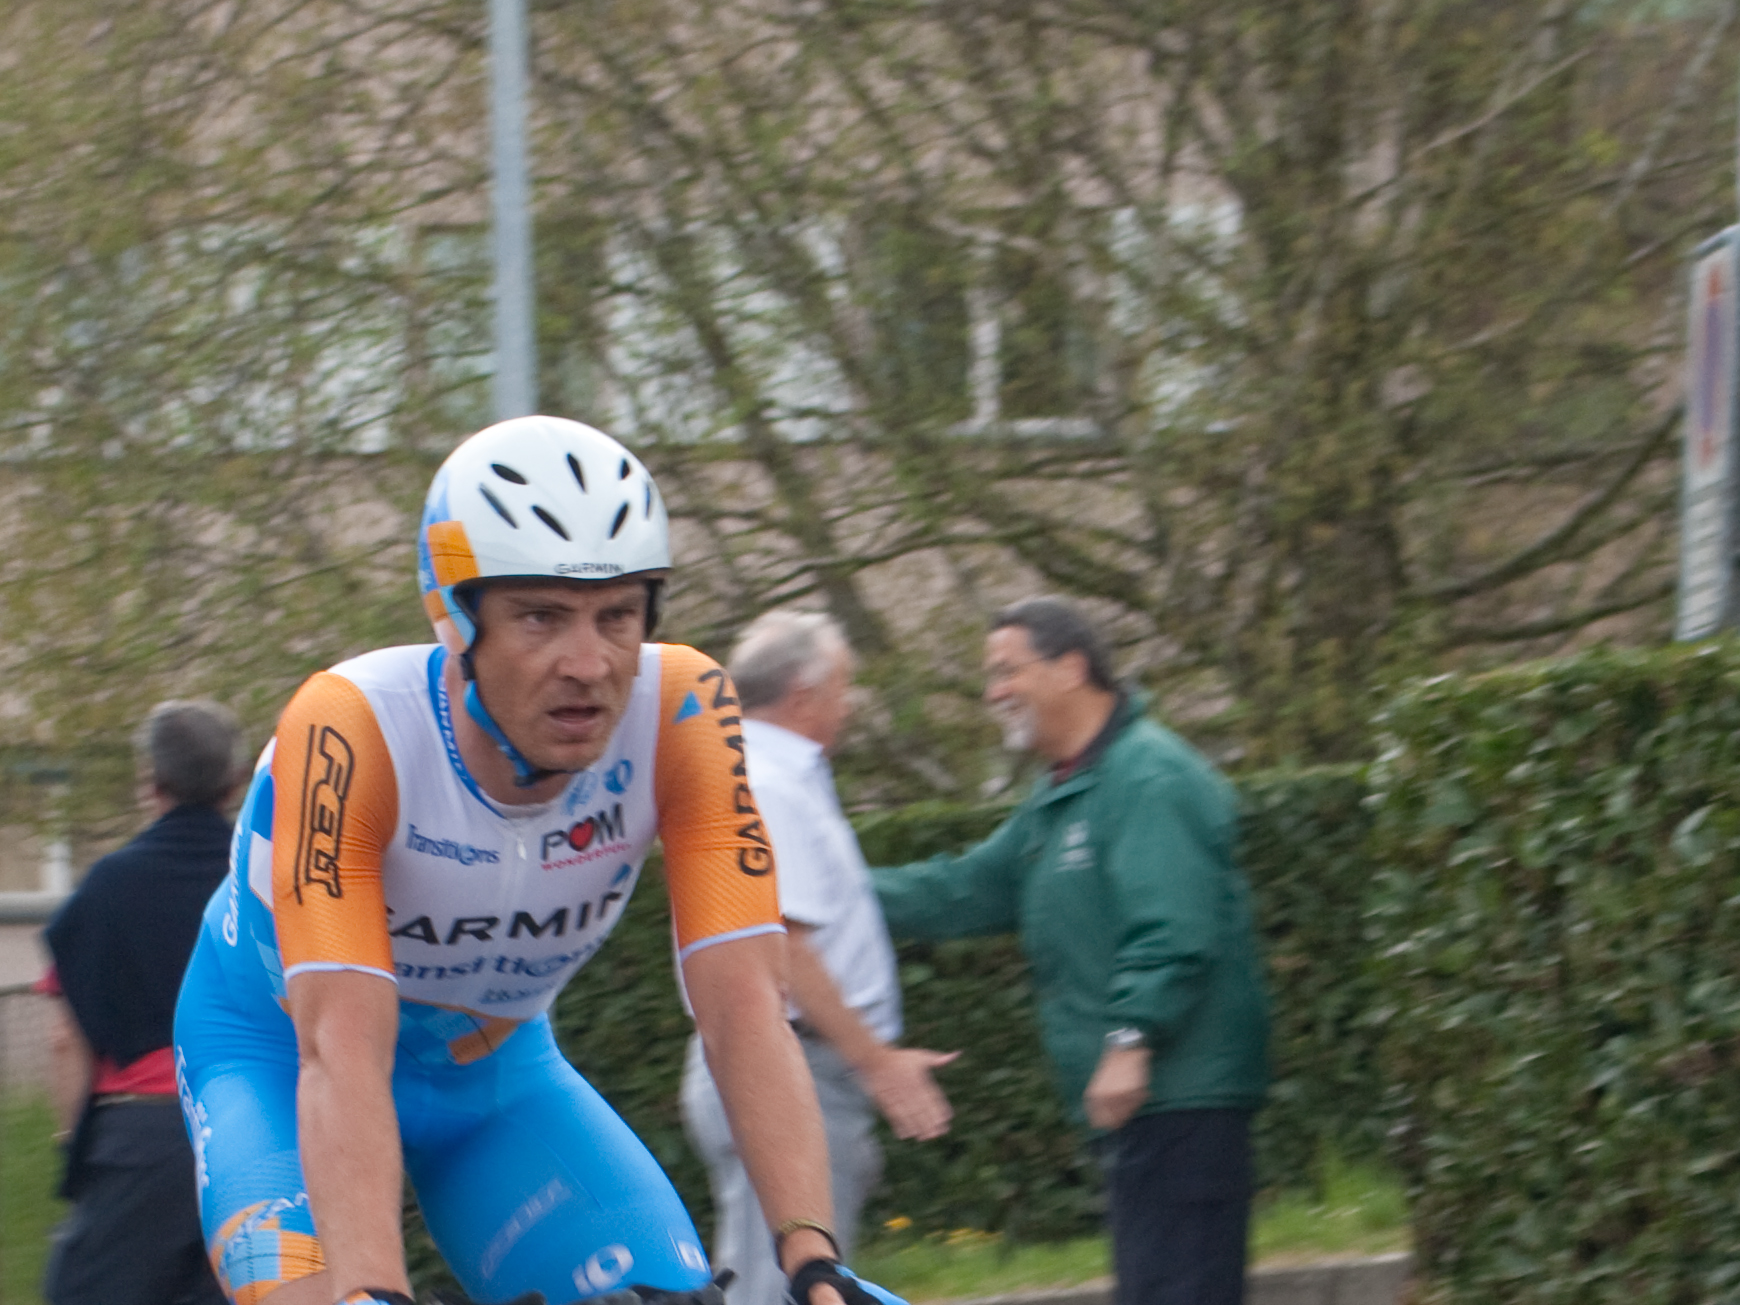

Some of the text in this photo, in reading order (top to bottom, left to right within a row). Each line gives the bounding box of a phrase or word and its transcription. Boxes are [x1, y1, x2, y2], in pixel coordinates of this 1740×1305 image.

[554, 563, 624, 574] GARMIN
[698, 668, 771, 877] GARMIN
[305, 725, 354, 898] FELT
[406, 823, 500, 866] Transitions
[384, 892, 622, 946] ARMI
